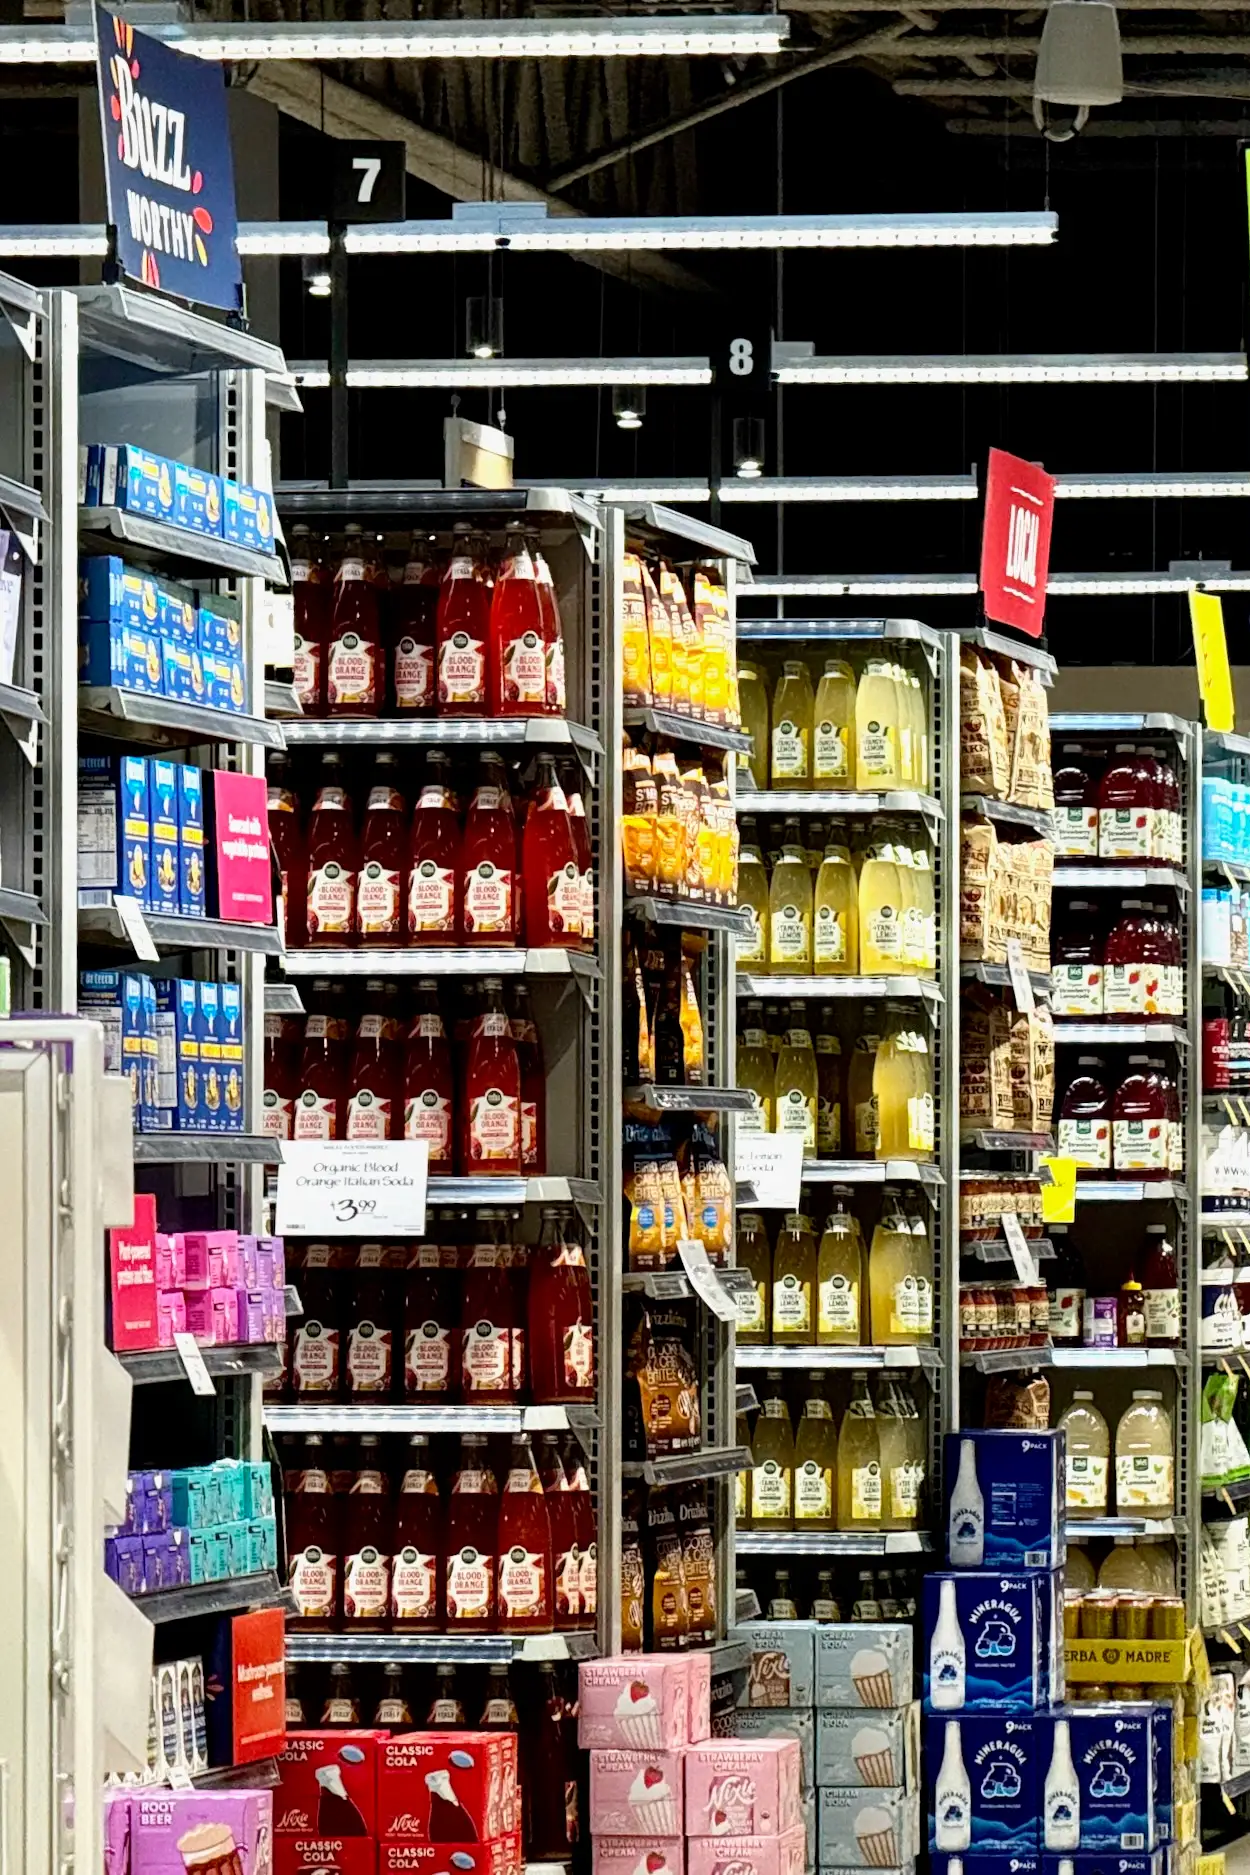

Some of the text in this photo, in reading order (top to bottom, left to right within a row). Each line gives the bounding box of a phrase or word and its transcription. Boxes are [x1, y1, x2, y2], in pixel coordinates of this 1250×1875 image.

[351, 158, 381, 203] 7
[126, 188, 196, 262] WORTHY
[728, 338, 754, 376] 8
[1005, 504, 1040, 588] LOCAL
[337, 657, 364, 666] BLOOD
[448, 655, 475, 665] BLOOD
[335, 666, 367, 675] ORANGE
[445, 665, 477, 674] ORANGE
[418, 885, 441, 893] BLOOD
[475, 886, 498, 894] BLOOD
[416, 892, 443, 900] ORANGE
[473, 893, 501, 901] ORANGE
[484, 1114, 506, 1122] BLOOD
[481, 1121, 509, 1129] ORANGE
[313, 1161, 400, 1175] Organic Blood
[296, 1175, 415, 1189] Orange Italian Soda
[302, 1570, 325, 1578] BLOOD
[357, 1570, 380, 1578] BLOOD
[456, 1571, 482, 1580] BLOOD
[508, 1569, 530, 1577] BLOOD
[299, 1578, 327, 1586] ORANGE
[355, 1578, 383, 1586] ORANGE
[454, 1579, 486, 1589] ORANGE
[506, 1577, 533, 1585] ORANGE
[968, 1598, 1023, 1625] MINERAGUA
[1064, 1650, 1171, 1664] ERBA MADRE
[584, 1667, 649, 1679] STRAWBERRY
[584, 1677, 621, 1687] CREAM
[386, 1745, 434, 1756] CLASSIC
[973, 1739, 1029, 1766] MINERAGUA
[1082, 1739, 1138, 1765] MINERAGUA
[277, 1751, 308, 1762] COLA
[699, 1751, 764, 1763] STRAWBERRY
[386, 1757, 418, 1767] COLA
[597, 1763, 635, 1773] CREAM
[713, 1762, 750, 1773] CREAM
[140, 1801, 176, 1815] ROOT
[141, 1814, 173, 1827] BEER
[387, 1813, 421, 1834] Nixie
[295, 1840, 343, 1851] CLASSIC
[600, 1838, 666, 1850] STRAWBERRY
[701, 1838, 766, 1850] STRAWBERRY
[303, 1852, 335, 1862] COLA
[387, 1847, 436, 1858] CLASSIC
[600, 1848, 636, 1858] CREAM
[714, 1848, 751, 1858] CREAM
[388, 1858, 420, 1869] COLA
